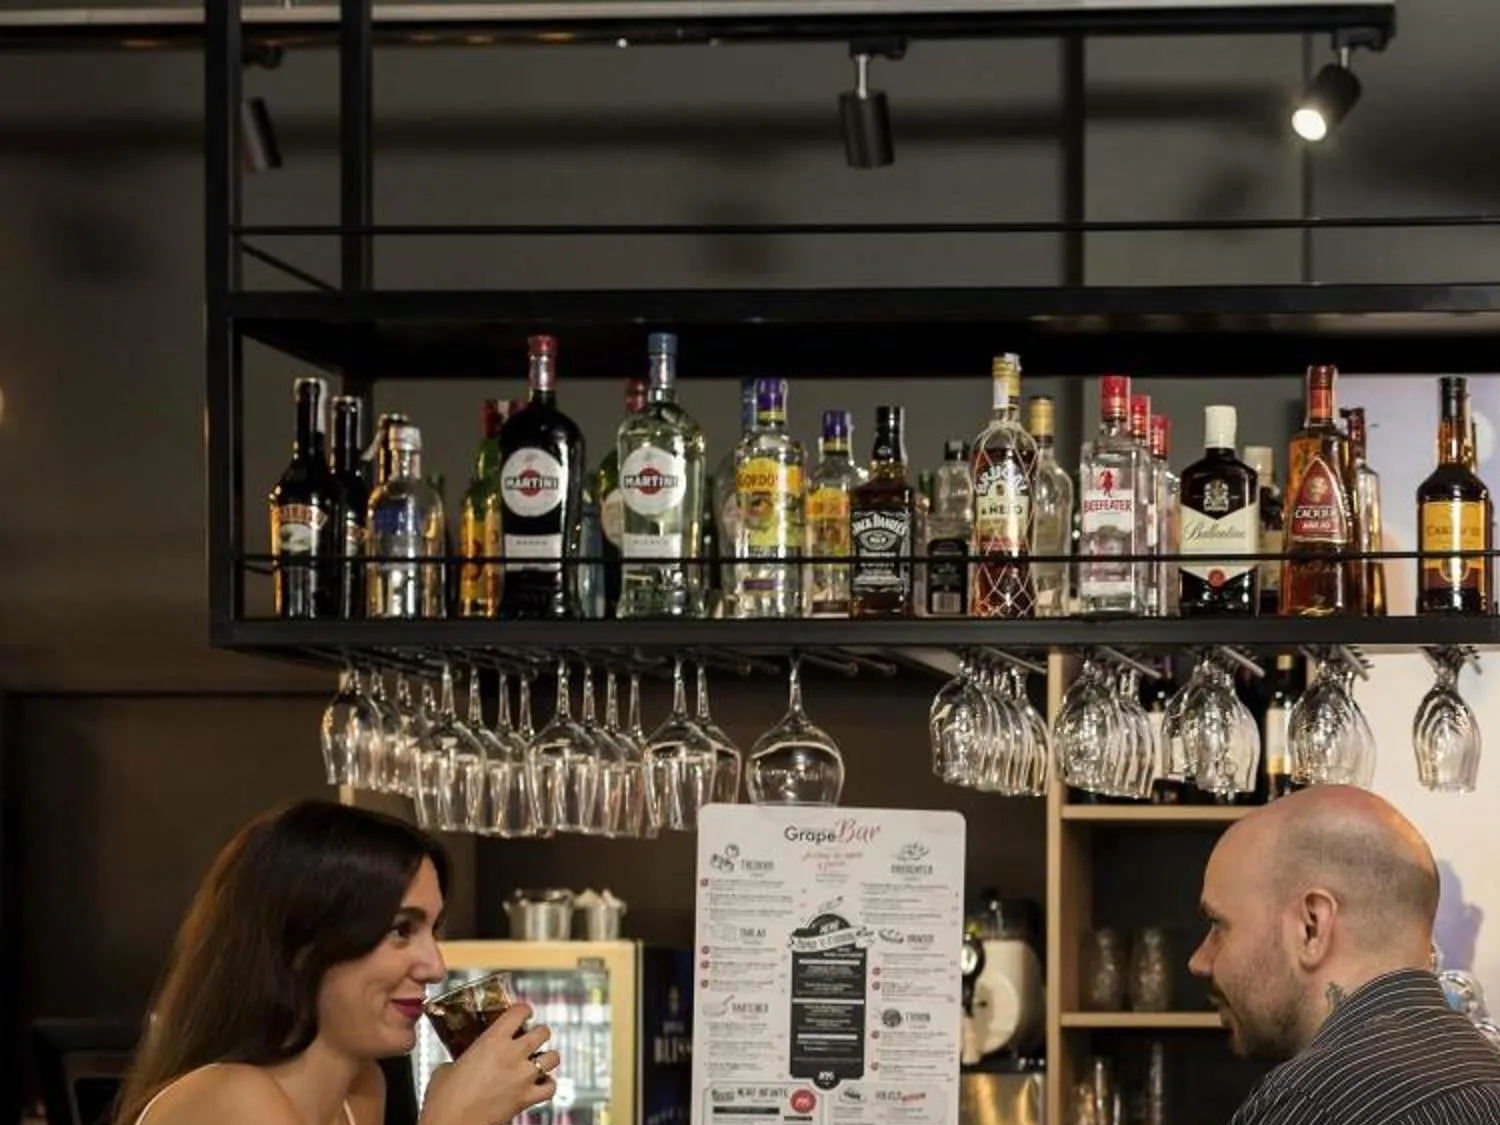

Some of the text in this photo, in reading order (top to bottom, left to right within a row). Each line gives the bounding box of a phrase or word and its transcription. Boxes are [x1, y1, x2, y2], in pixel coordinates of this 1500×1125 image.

[505, 476, 559, 490] MARTINI
[623, 474, 678, 489] MARTINI
[1083, 499, 1132, 513] BEEFEATER
[784, 819, 880, 844] Grape Bar
